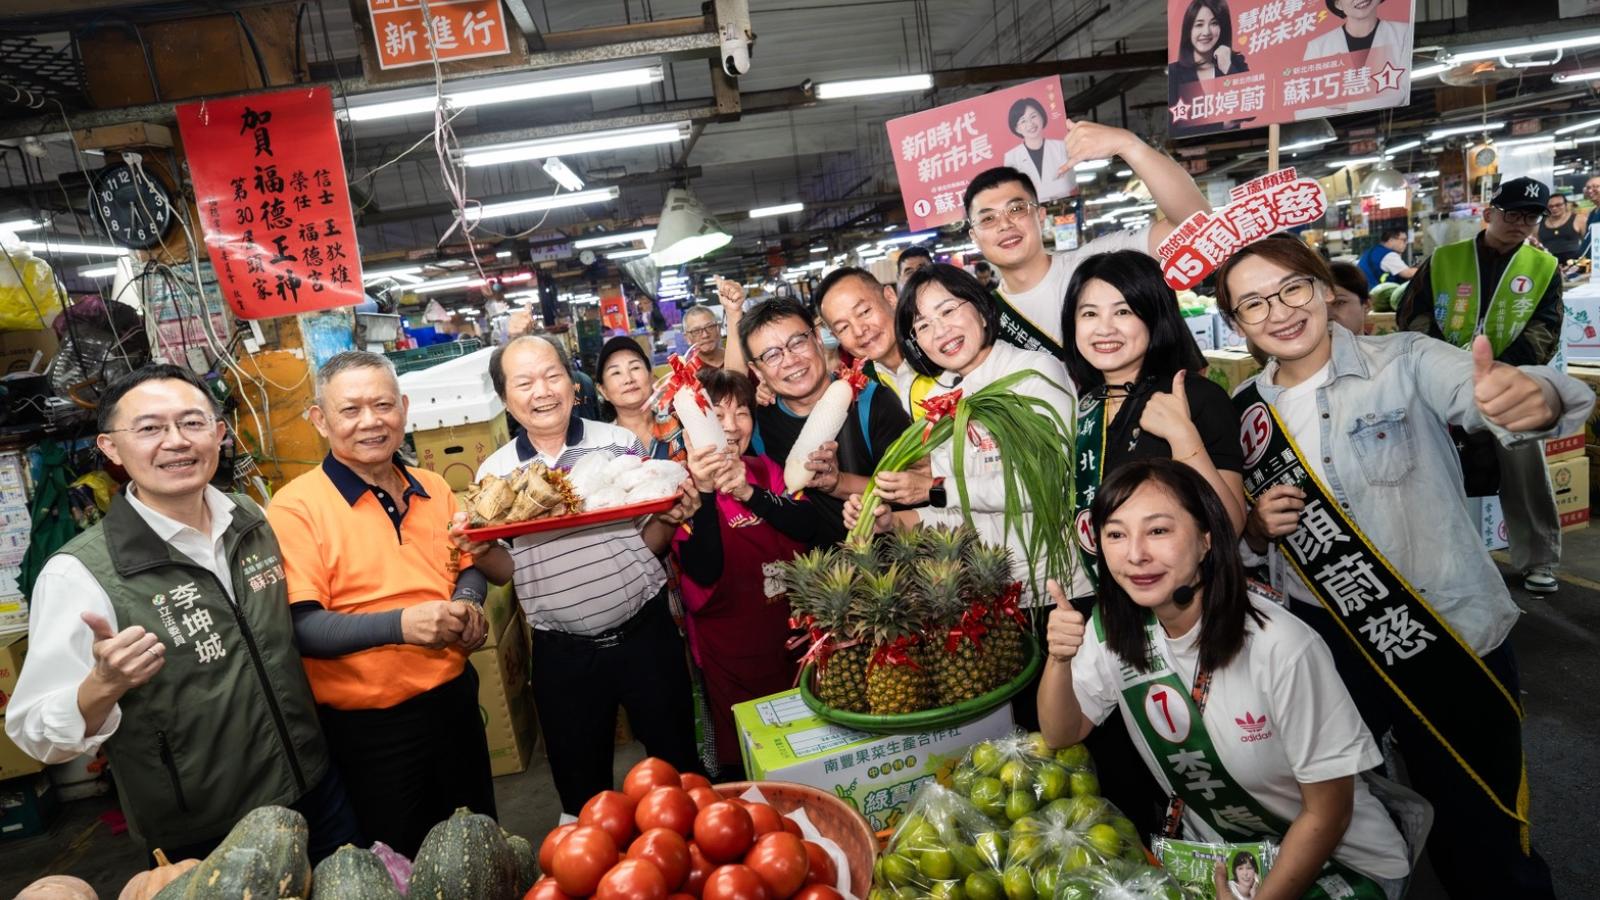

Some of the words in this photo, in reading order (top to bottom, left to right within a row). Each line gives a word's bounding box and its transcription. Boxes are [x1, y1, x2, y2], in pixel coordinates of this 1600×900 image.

[384, 11, 495, 57] 新進行
[1238, 0, 1305, 34] 慧做事
[1283, 66, 1372, 107] 蘇巧慧
[1381, 71, 1391, 85] 1
[1174, 105, 1187, 117] 13
[1190, 84, 1266, 120] 邱婷蔚
[240, 106, 273, 157] 賀
[901, 111, 979, 162] 新時代
[917, 134, 994, 183] 新市長
[107, 178, 118, 190] 11
[118, 171, 130, 183] 12
[136, 173, 142, 184] 1
[1524, 183, 1540, 198] NY
[101, 191, 113, 202] 10
[103, 206, 111, 217] 9
[111, 220, 119, 231] 8
[124, 228, 131, 239] 7
[156, 211, 164, 222] 4
[254, 164, 302, 303] 福德正神
[1193, 185, 1320, 266] 顏蔚慈
[138, 229, 146, 240] 6
[1159, 212, 1208, 259] 你的議員
[1166, 252, 1204, 285] 15
[1516, 278, 1528, 292] 7
[1000, 311, 1053, 355] 新北市議
[1242, 410, 1268, 460] 15
[1286, 499, 1437, 667] 顏蔚慈
[169, 581, 226, 664] 李坤城
[1151, 691, 1177, 733] 7
[824, 728, 962, 774] 南豐果菜生產合作社
[1240, 730, 1273, 743] adidas
